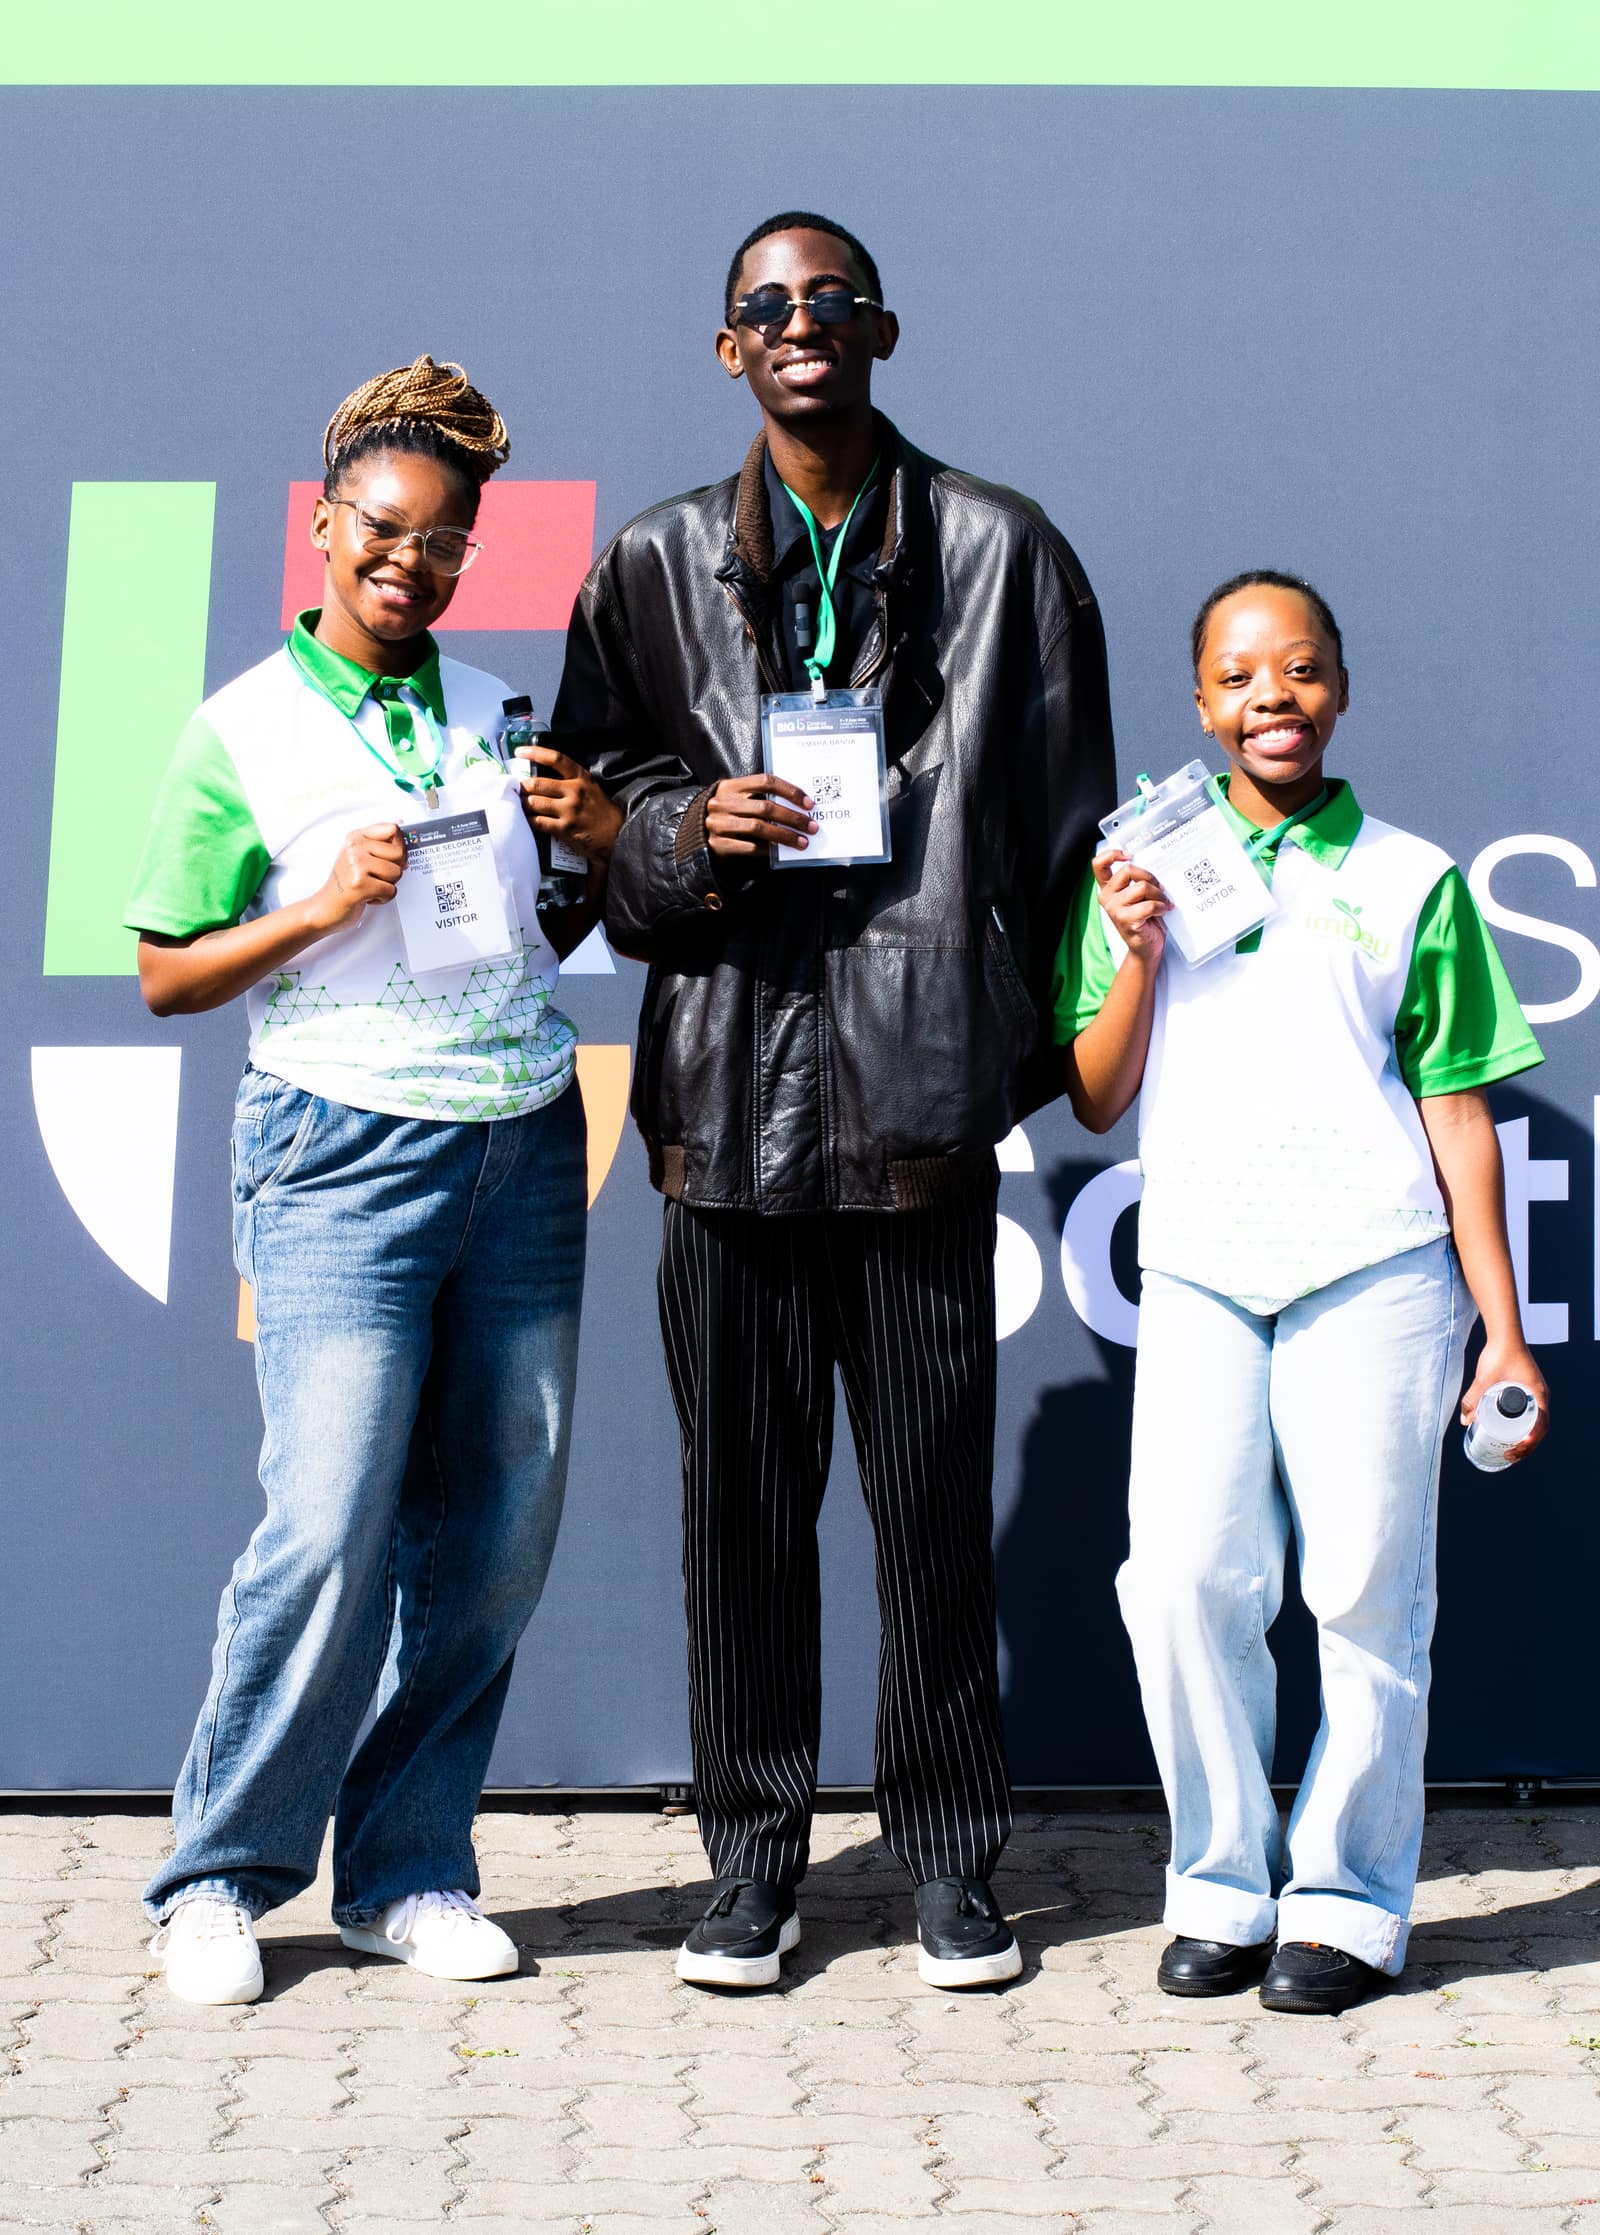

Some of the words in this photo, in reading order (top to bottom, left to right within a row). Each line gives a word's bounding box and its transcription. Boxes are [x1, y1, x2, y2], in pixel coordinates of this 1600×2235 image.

[776, 722, 795, 733] BIG
[807, 809, 851, 820] VISITOR
[407, 846, 440, 858] RENEILE
[1196, 884, 1237, 912] VISITOR
[435, 913, 478, 929] VISITOR
